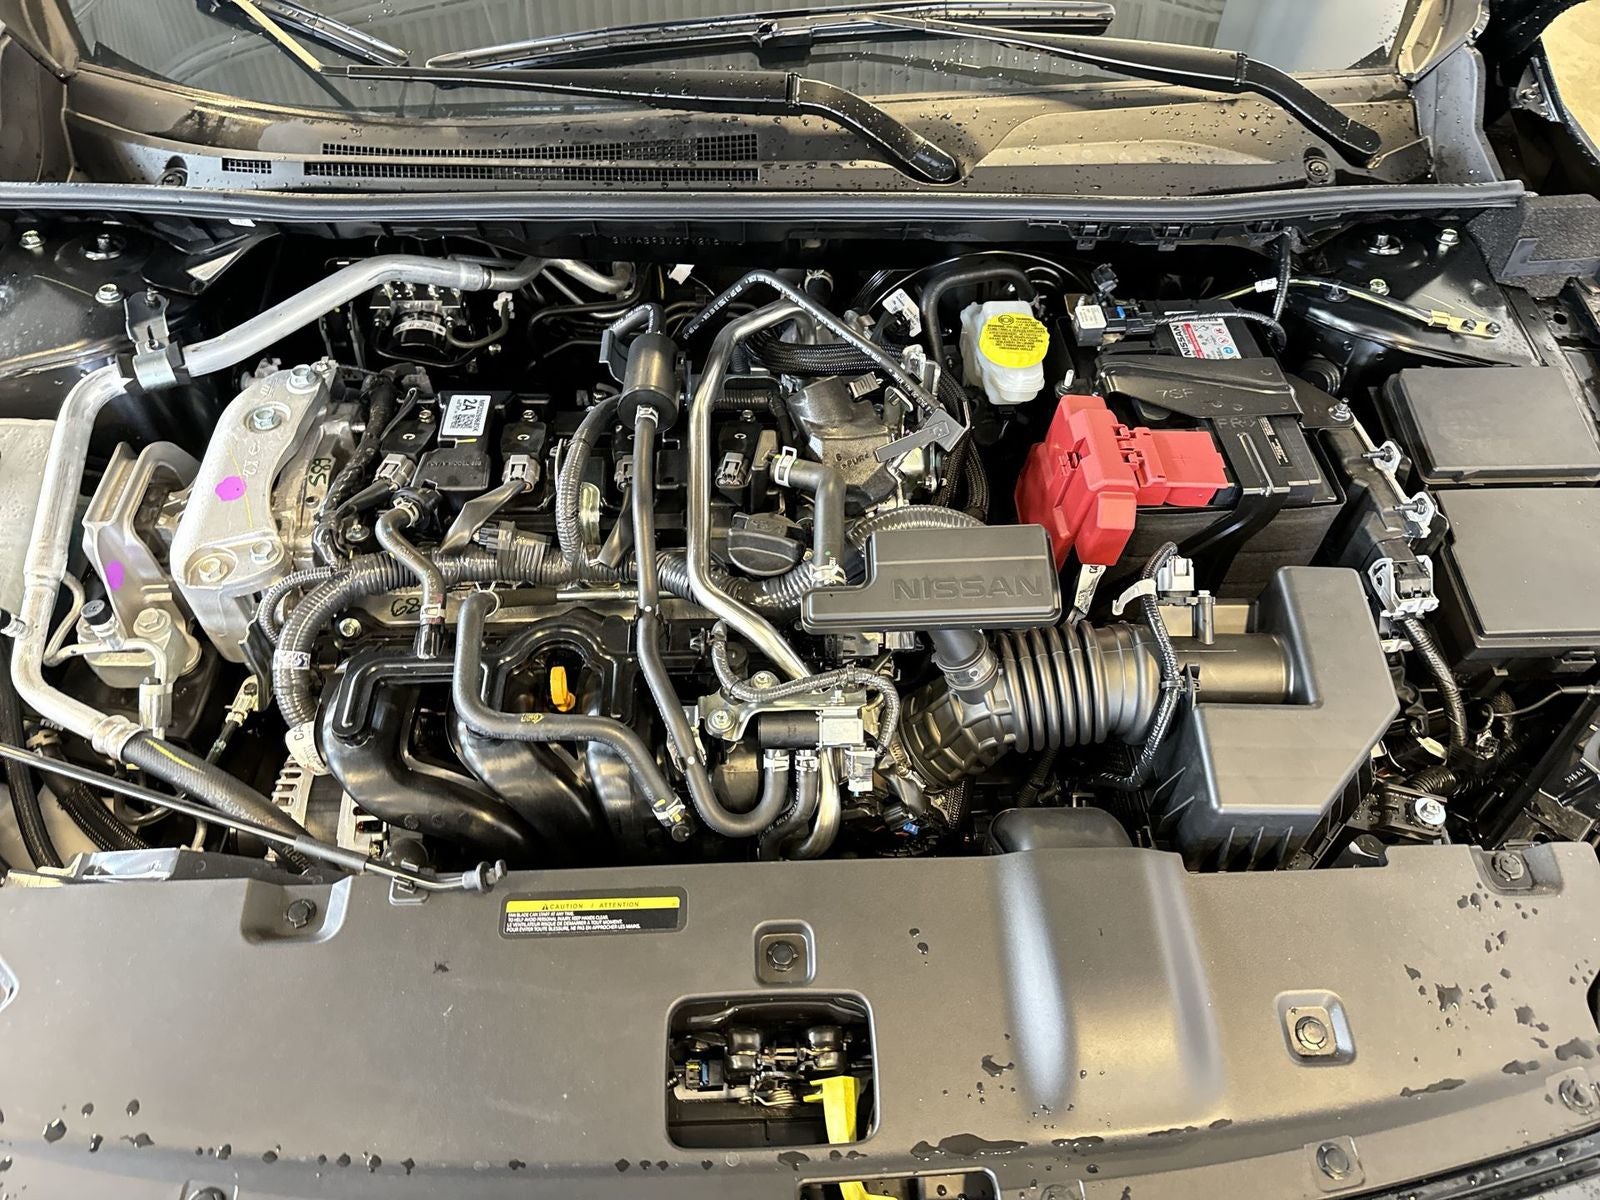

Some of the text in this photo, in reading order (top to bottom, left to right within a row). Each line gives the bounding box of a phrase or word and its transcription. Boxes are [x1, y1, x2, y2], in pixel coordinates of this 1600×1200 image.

[1172, 324, 1191, 357] NISSAN
[461, 398, 478, 411] 2A
[891, 575, 1044, 601] NISSAN
